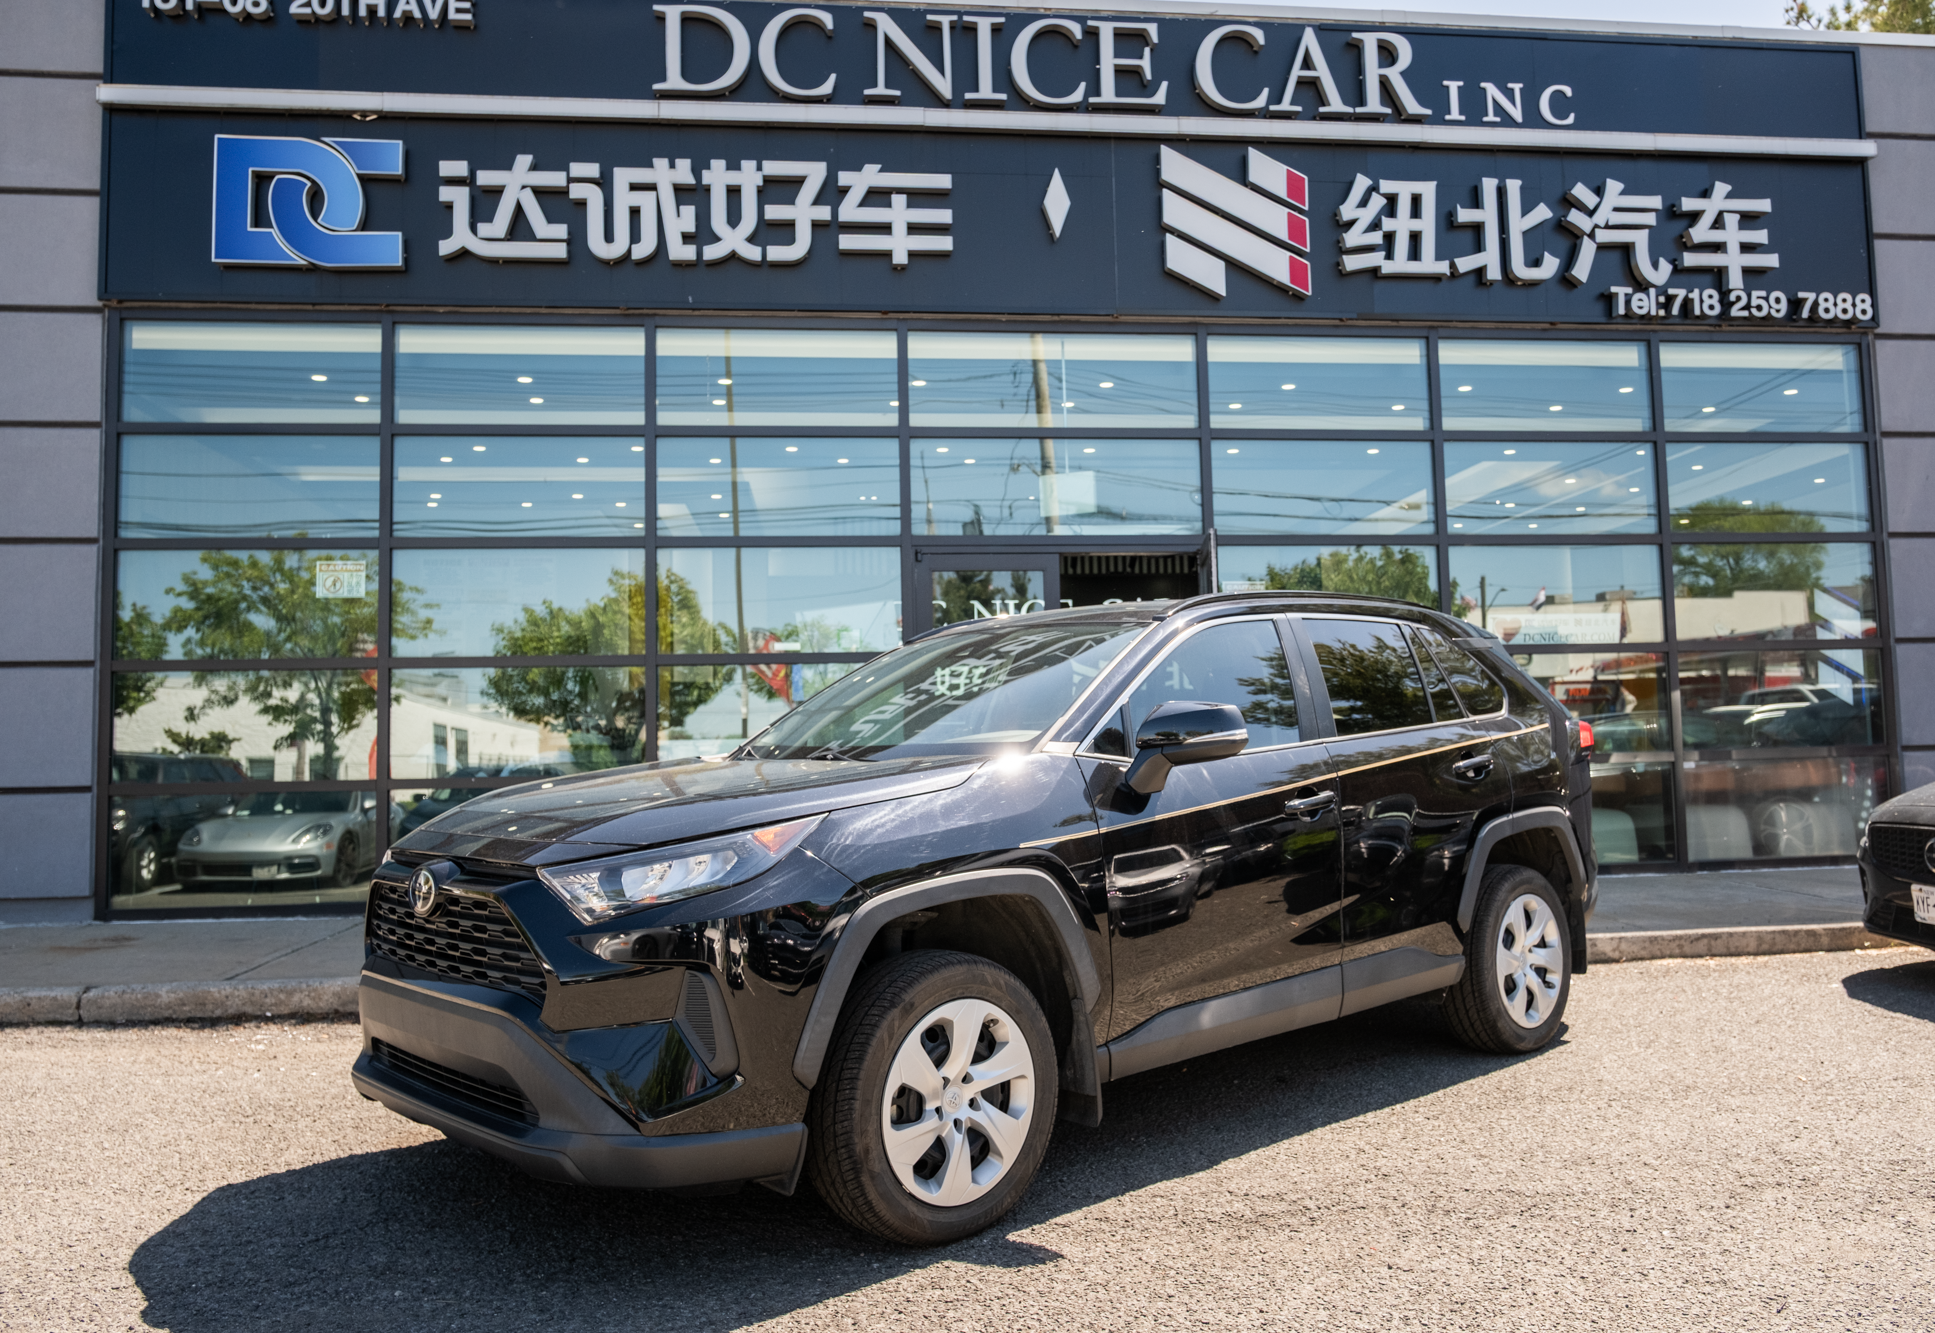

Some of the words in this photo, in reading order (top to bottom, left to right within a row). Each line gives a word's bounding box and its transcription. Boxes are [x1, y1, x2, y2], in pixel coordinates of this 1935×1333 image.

[652, 4, 837, 99] DC
[863, 11, 1168, 109] NICE
[1194, 24, 1433, 118] CAR
[1443, 80, 1576, 126] INC
[438, 154, 954, 268] 达诚好车
[1338, 173, 1780, 290] 纽北汽车
[1610, 284, 1721, 317] Tel:718
[1729, 288, 1788, 319] 259
[1797, 291, 1874, 323] 7888
